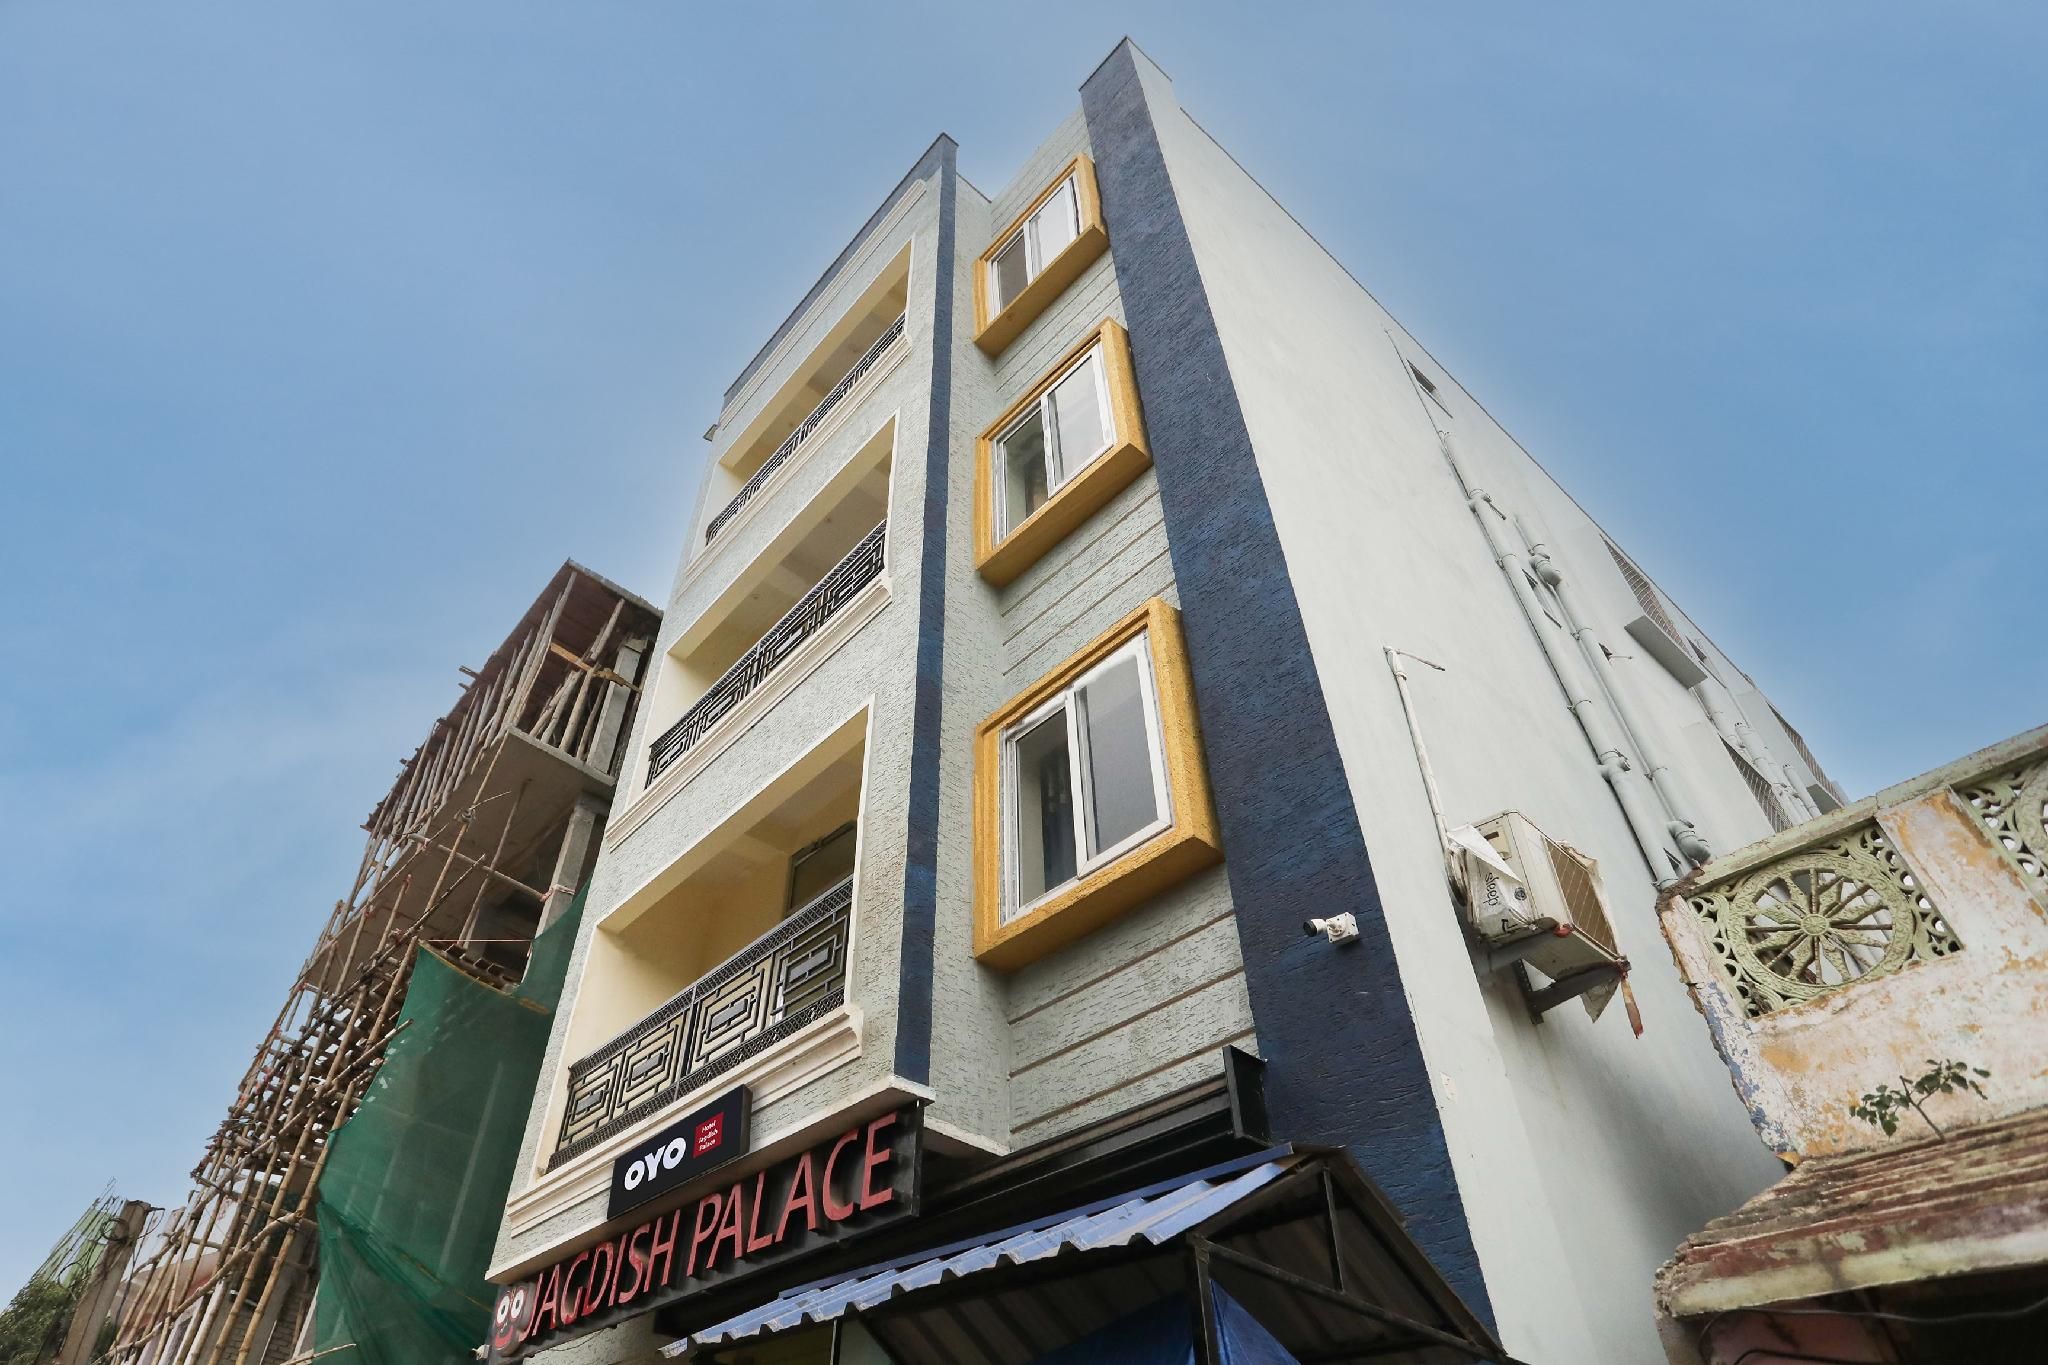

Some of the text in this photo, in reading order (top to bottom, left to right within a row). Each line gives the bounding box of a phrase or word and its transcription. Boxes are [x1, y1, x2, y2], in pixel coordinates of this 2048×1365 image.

[519, 1112, 898, 1343] JAGDISH PALACE
[624, 1137, 687, 1190] OYO
